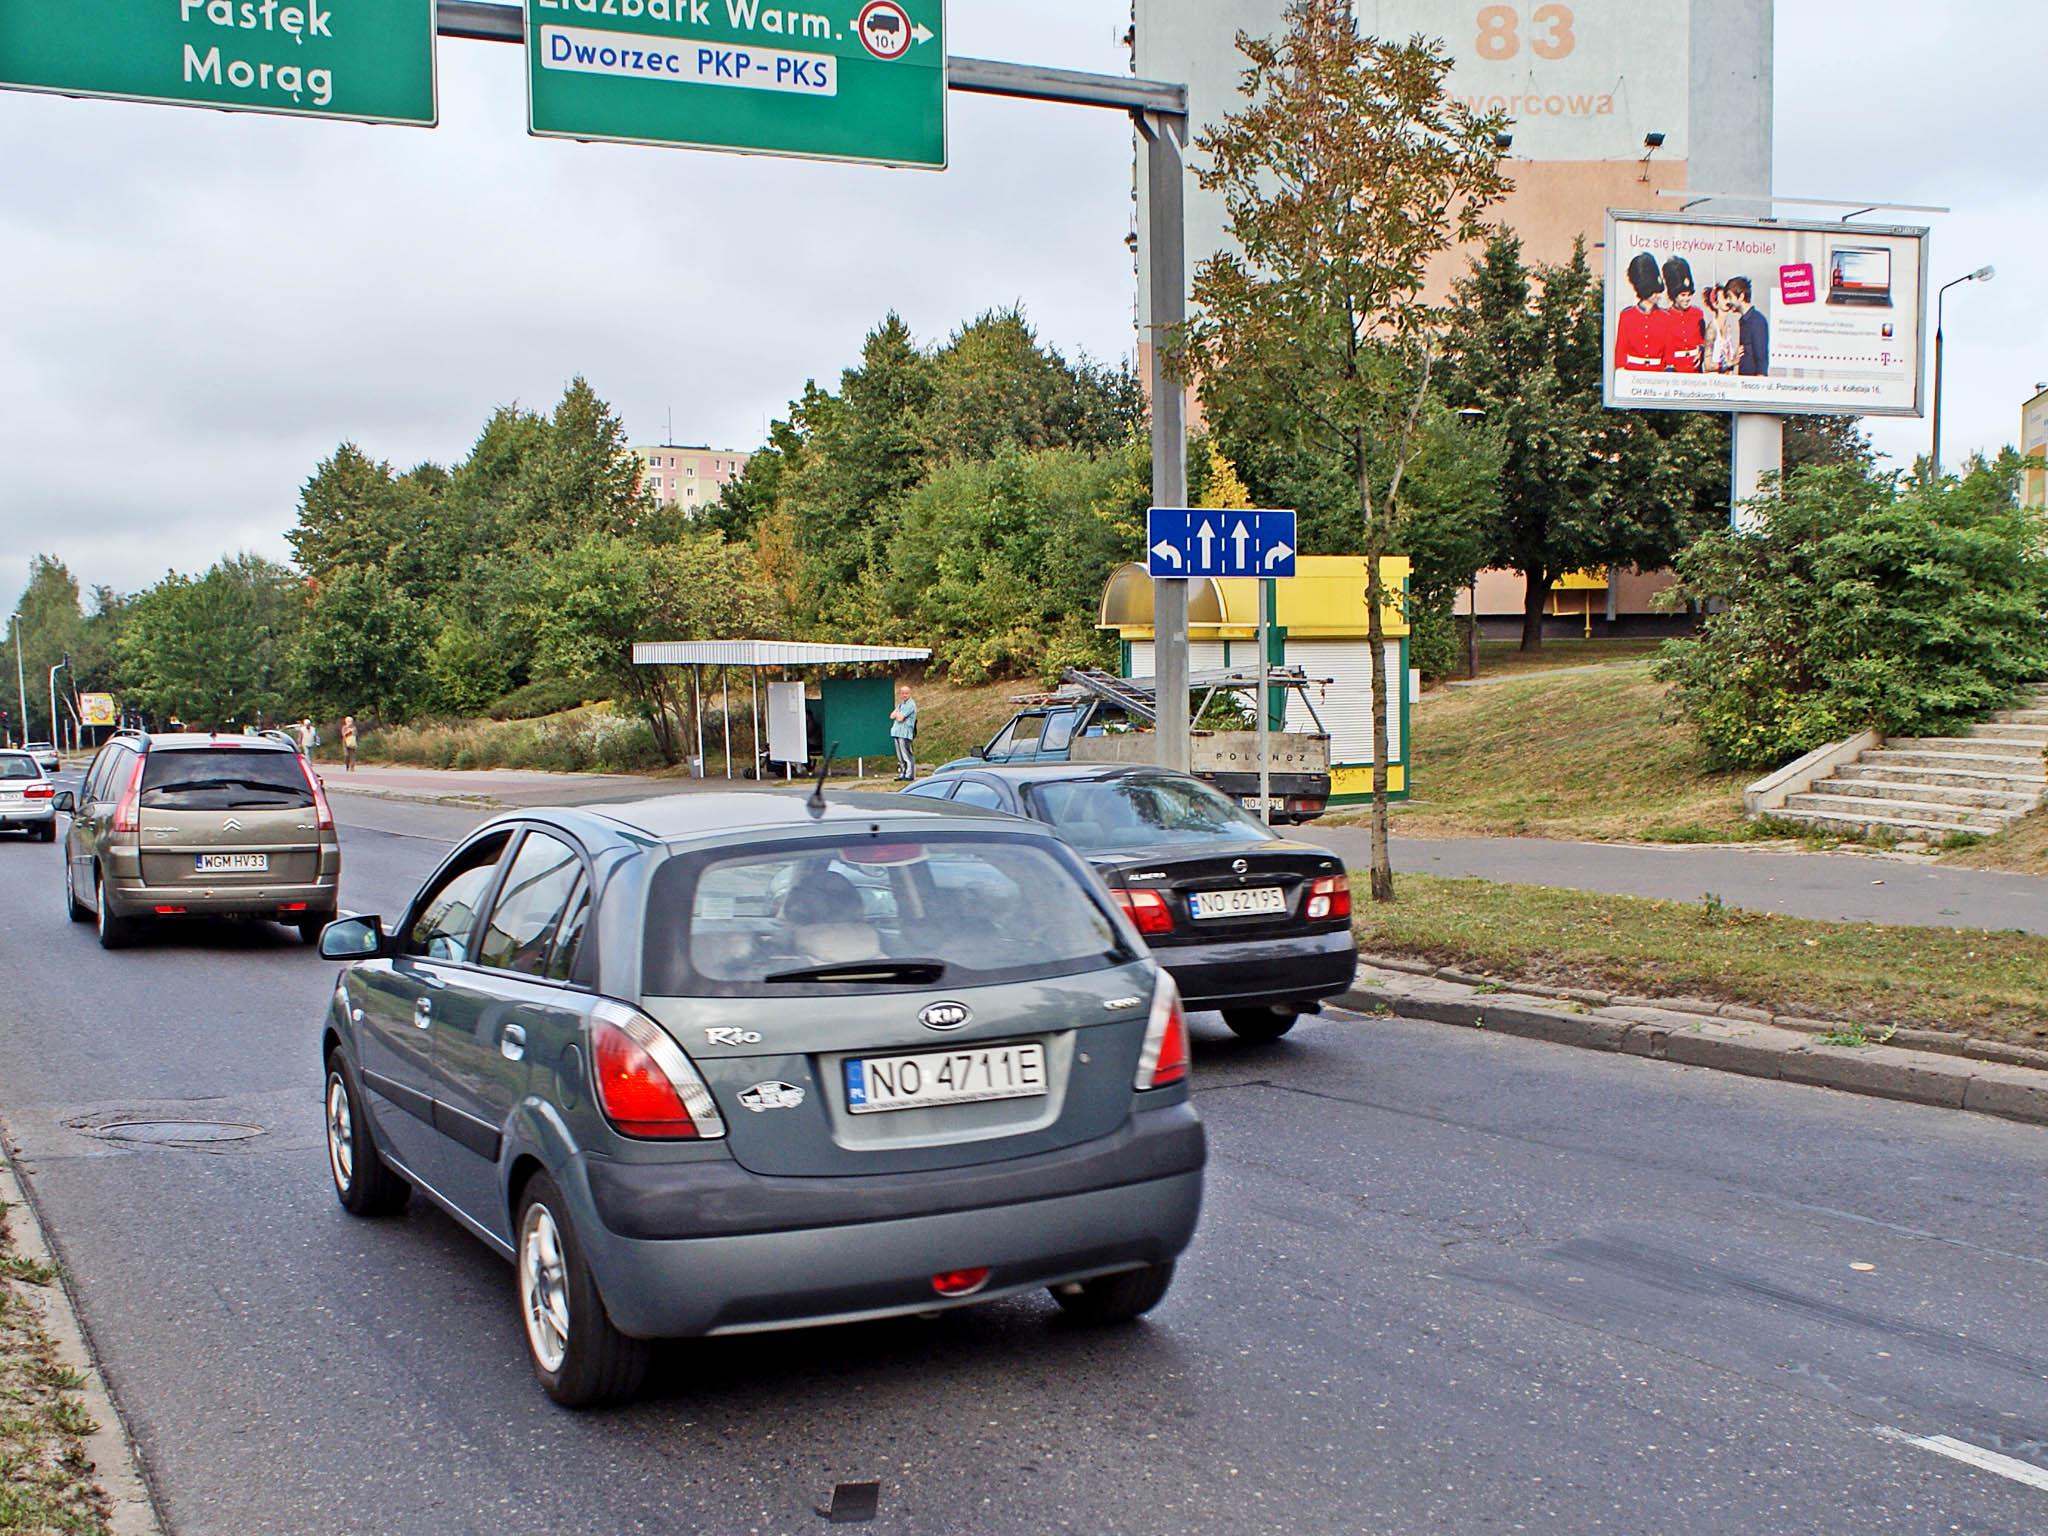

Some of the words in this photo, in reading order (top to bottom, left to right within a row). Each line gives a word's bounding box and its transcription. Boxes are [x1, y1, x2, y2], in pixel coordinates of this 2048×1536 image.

[180, 0, 333, 45] Pasłęk
[540, 0, 711, 26] dzbark
[725, 0, 843, 40] Warm.
[1475, 4, 1576, 61] 83
[551, 34, 680, 74] Dworzec
[875, 35, 889, 48] 10
[183, 43, 333, 106] Morąg
[1440, 91, 1615, 117] worcowa
[1629, 234, 1651, 247] Ucz
[1653, 236, 1669, 250] się
[1672, 237, 1714, 253] języków
[1717, 242, 1726, 252] z
[1727, 239, 1776, 255] T-Mobile!
[204, 856, 231, 868] WGM
[235, 855, 265, 867] HV33
[1199, 893, 1226, 913] NO
[1231, 889, 1281, 911] 62195
[926, 1007, 964, 1025] KIA
[705, 1026, 762, 1047] Rio
[871, 1060, 922, 1099] NO
[937, 1049, 1039, 1091] 4711E
